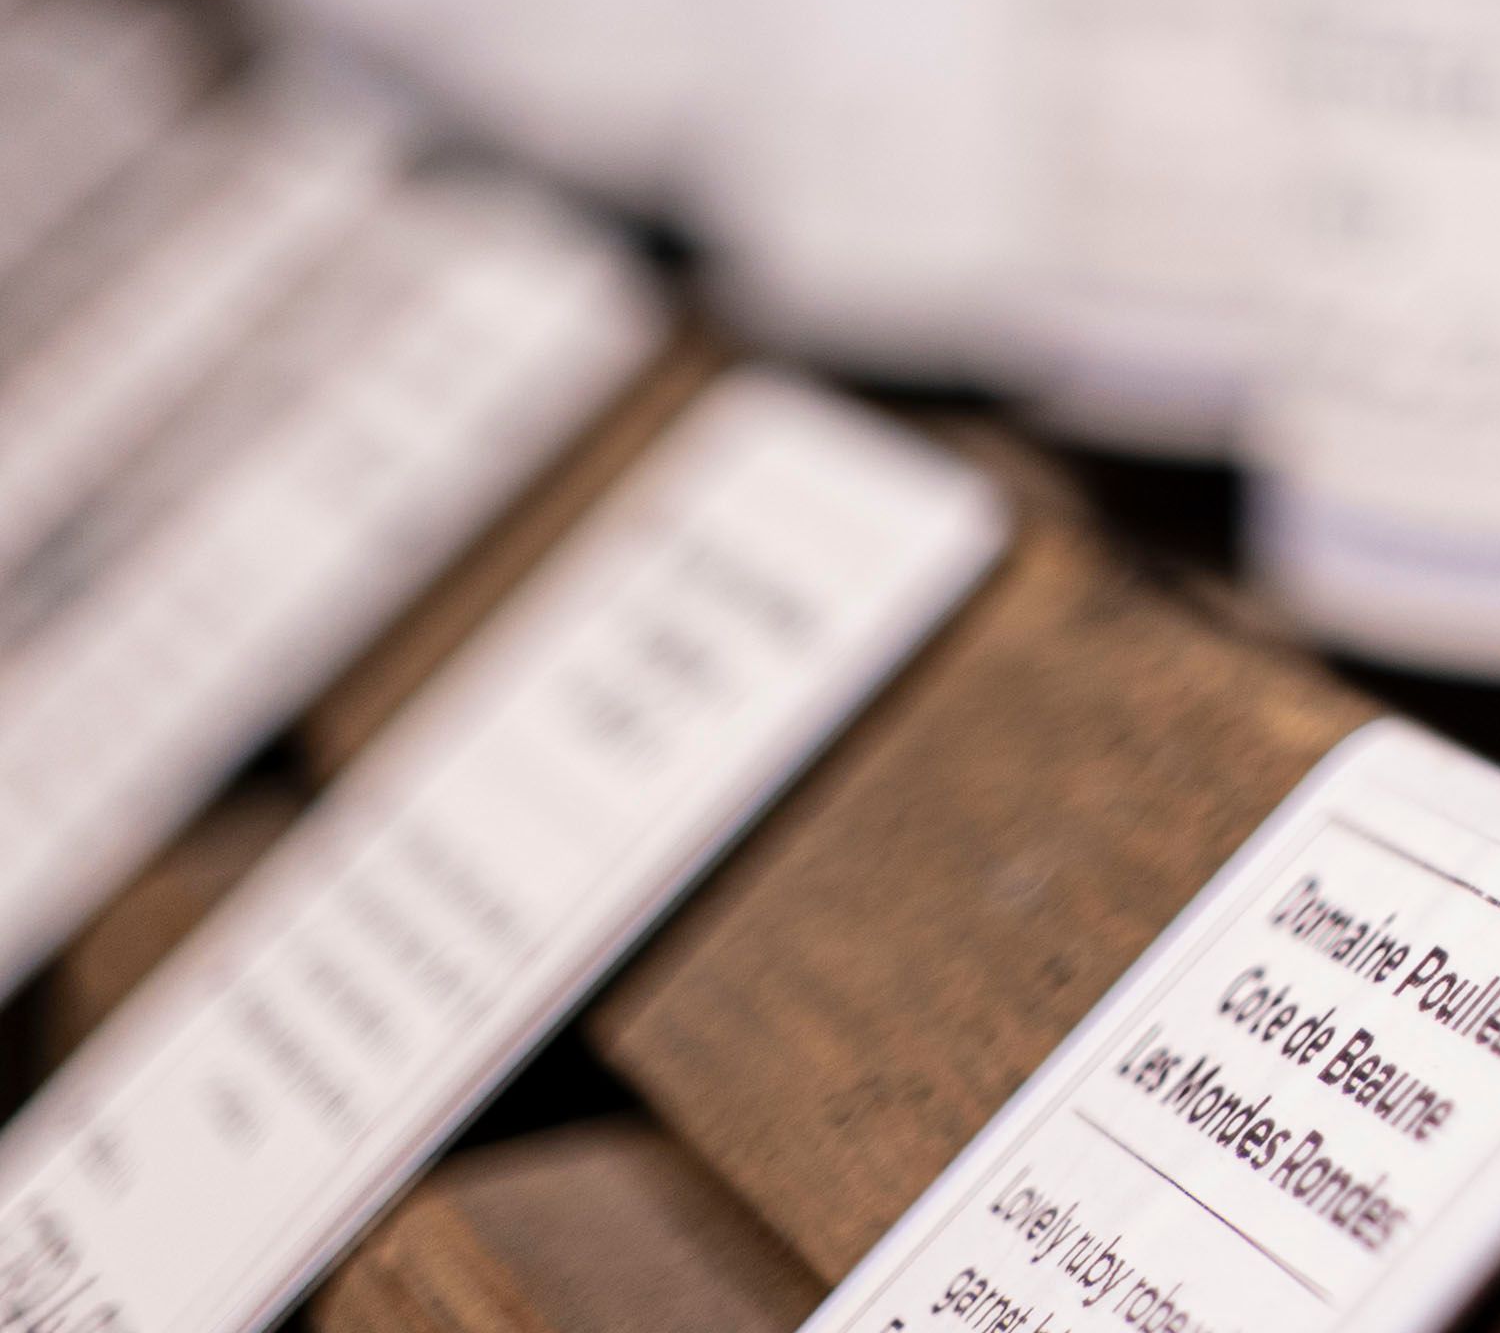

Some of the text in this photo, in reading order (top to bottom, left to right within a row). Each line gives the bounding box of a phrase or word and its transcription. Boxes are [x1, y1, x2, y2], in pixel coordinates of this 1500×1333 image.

[1269, 873, 1411, 984] Domaine
[1117, 1020, 1408, 1253] Les Mondes Rondes
[1281, 1006, 1338, 1065] de
[1317, 1027, 1455, 1141] Beaune
[990, 1166, 1081, 1264] Lovely
[1058, 1232, 1135, 1308] ruby
